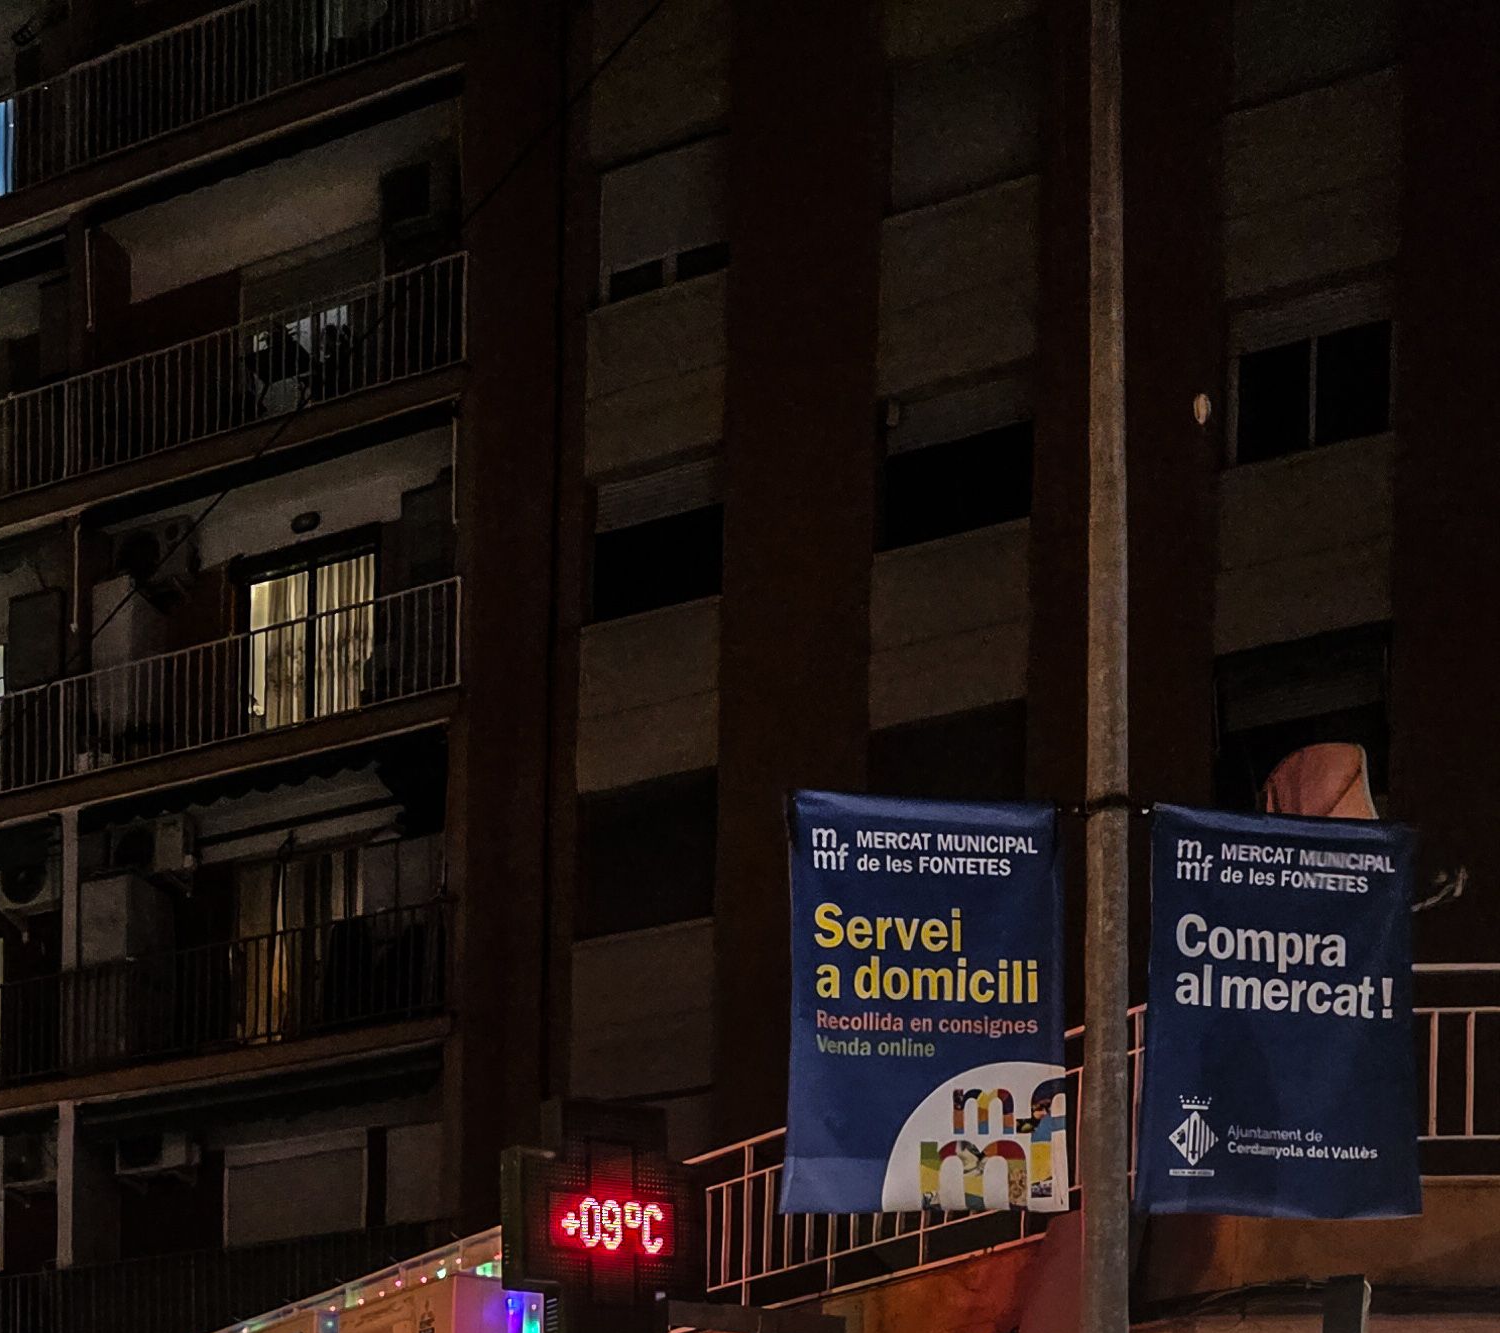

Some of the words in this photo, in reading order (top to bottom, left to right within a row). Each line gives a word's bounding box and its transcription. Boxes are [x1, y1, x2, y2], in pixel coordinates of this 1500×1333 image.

[856, 830, 932, 851] MERCAT
[937, 833, 1038, 855] MUNICIPAL
[856, 853, 881, 873] de
[886, 854, 914, 874] les
[918, 856, 1012, 877] FONTETES
[1220, 843, 1295, 867] MERCAT
[1299, 848, 1397, 874] MUNICIPAL
[1219, 866, 1244, 885] de
[1249, 868, 1276, 887] les
[1280, 869, 1369, 894] FONTETES
[814, 902, 962, 952] Servei
[1175, 913, 1348, 974] Compra
[815, 963, 841, 999] a
[853, 955, 1039, 1004] domicili
[1174, 963, 1214, 1008] al
[816, 1009, 904, 1032] Recollida
[910, 1016, 934, 1034] en
[938, 1016, 1040, 1040] consignes
[816, 1033, 872, 1056] Venda
[877, 1037, 936, 1059] online
[1227, 1124, 1303, 1143] Ajuntament
[1304, 1128, 1324, 1144] de
[1227, 1140, 1304, 1161] Cerdanyola
[1306, 1144, 1329, 1160] del
